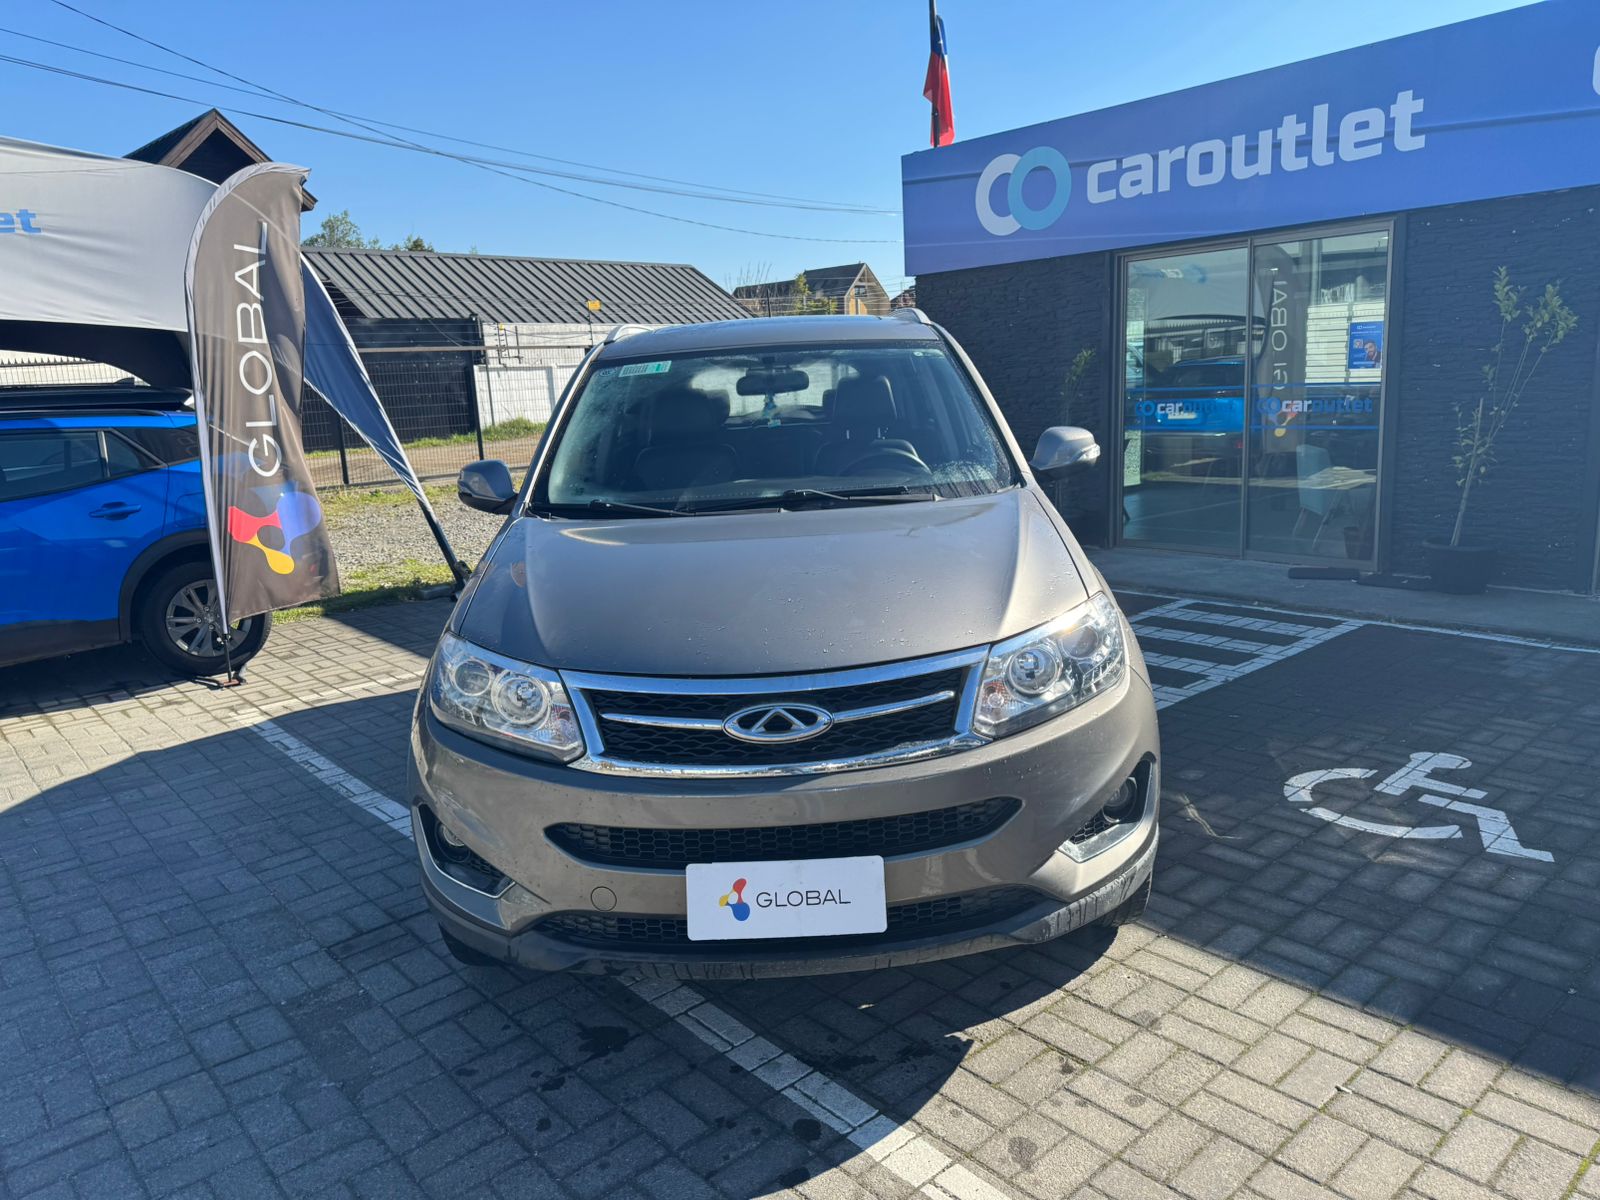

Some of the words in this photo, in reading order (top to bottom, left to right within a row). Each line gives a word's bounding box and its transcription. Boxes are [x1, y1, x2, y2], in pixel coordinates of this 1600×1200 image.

[1087, 90, 1426, 204] caroutlet
[233, 222, 281, 477] GLOBAL
[756, 889, 851, 908] GLOBAL
